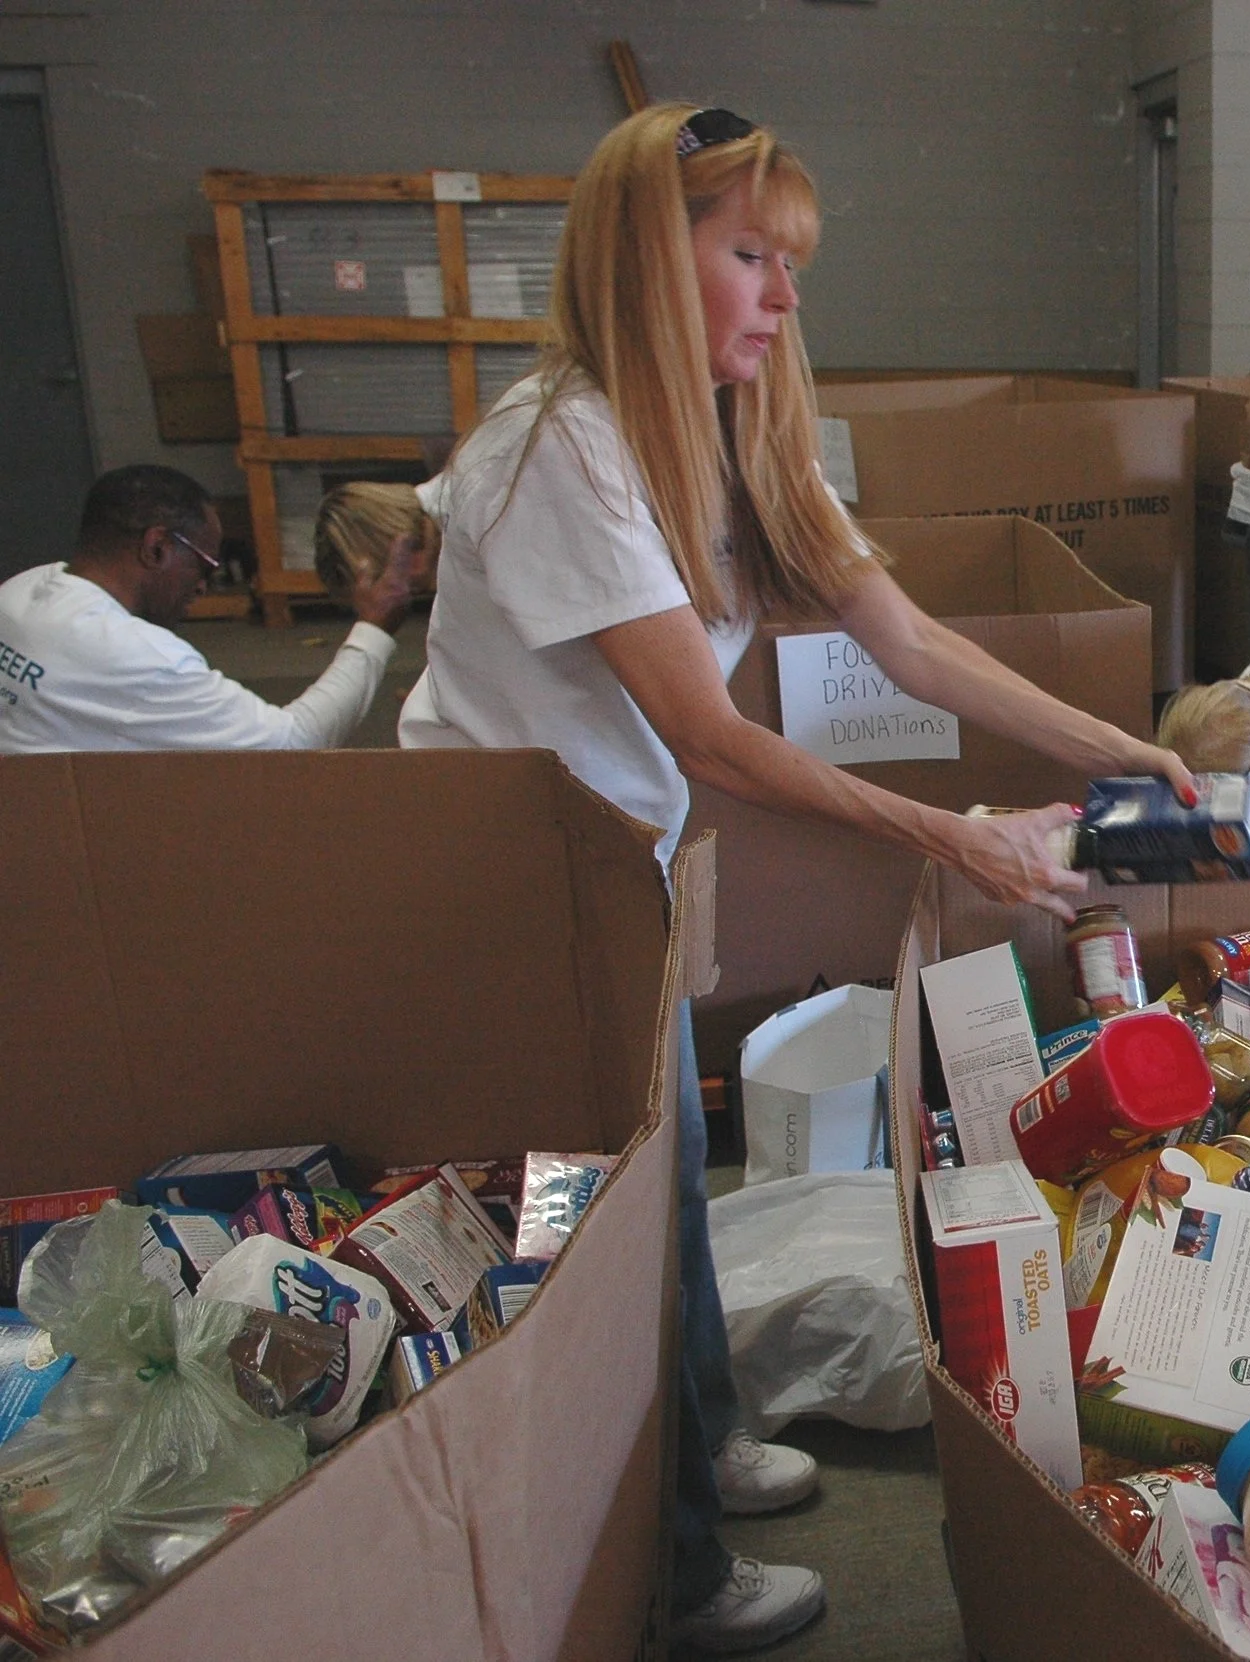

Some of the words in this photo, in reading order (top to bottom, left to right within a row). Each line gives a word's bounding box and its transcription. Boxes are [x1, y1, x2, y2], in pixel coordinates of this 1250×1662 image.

[1033, 506, 1052, 523] AT
[1056, 500, 1104, 523] LEAST
[1109, 499, 1119, 518] 5
[1122, 495, 1171, 517] TIMES
[0, 641, 46, 691] EER
[1046, 1028, 1087, 1056] Prince
[281, 1186, 315, 1247] Kellogg's
[1034, 1248, 1050, 1291] OATS
[272, 1267, 324, 1324] ott
[1022, 1258, 1041, 1332] TOASTED
[1012, 1298, 1026, 1335] original
[425, 1349, 443, 1377] SHAK
[996, 1384, 1015, 1416] IGA
